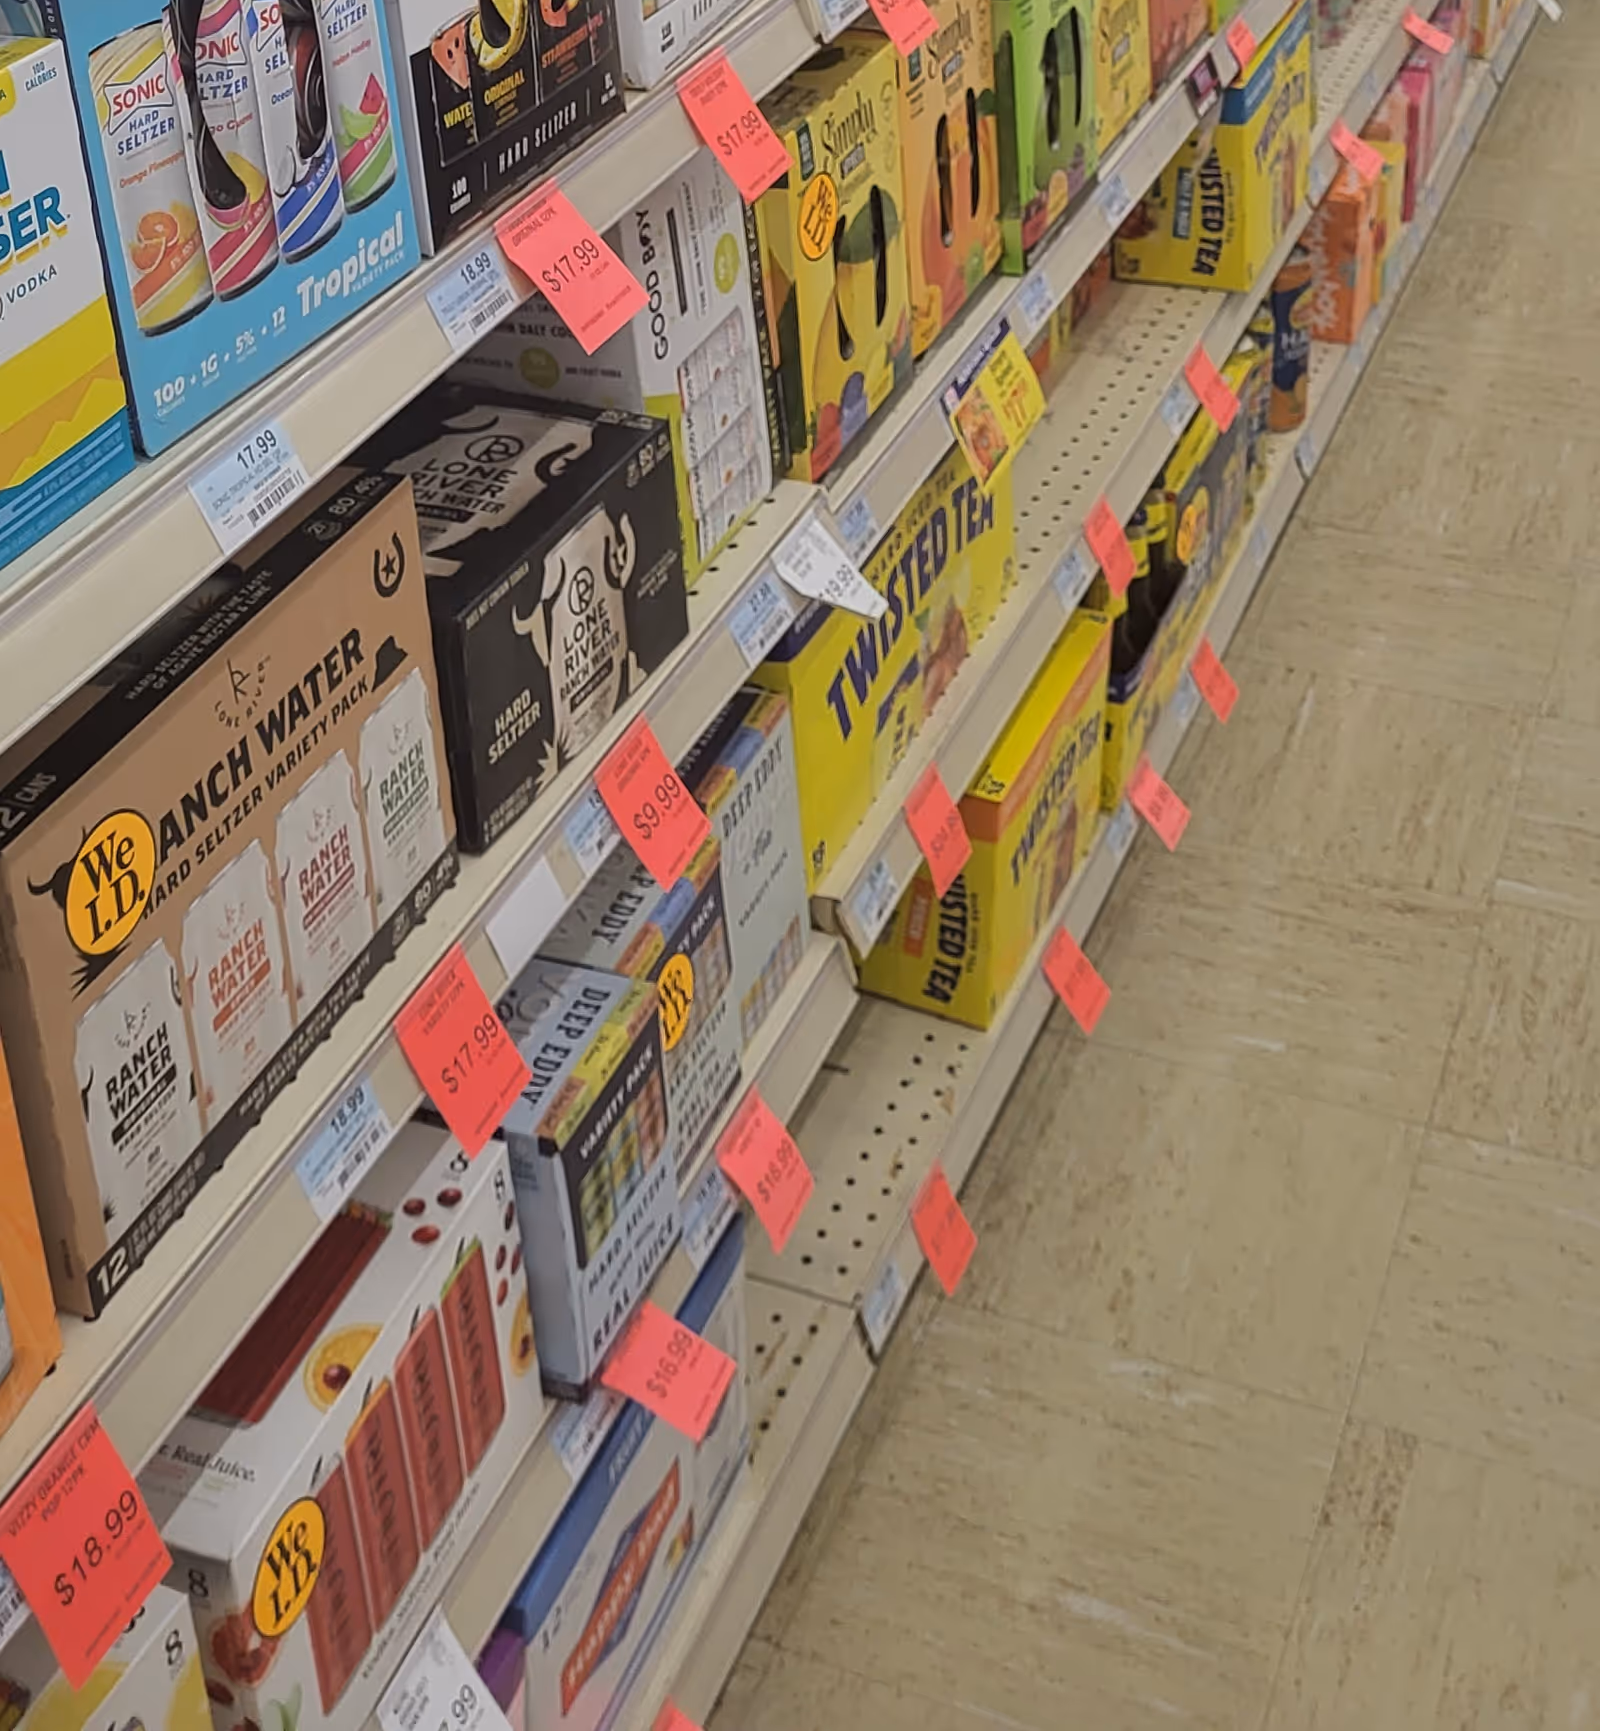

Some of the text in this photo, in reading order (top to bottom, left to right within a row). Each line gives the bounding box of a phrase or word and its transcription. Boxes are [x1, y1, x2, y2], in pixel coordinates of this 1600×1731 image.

[326, 4, 368, 40] SELTZER
[25, 66, 58, 93] CALORIES
[31, 60, 46, 75] 100
[113, 73, 167, 117] SONIC
[117, 117, 176, 157] SELTZER
[128, 109, 160, 134] HARD
[498, 100, 578, 176] HARD SELTZER
[716, 109, 763, 157] $17.99
[6, 264, 58, 306] VODKA
[297, 211, 404, 317] Tropical
[459, 250, 492, 285] 18.99
[541, 237, 601, 294] $17.99
[154, 376, 186, 407] 100
[234, 329, 256, 356] 5%
[272, 305, 287, 328] 12
[236, 428, 279, 471] 17.99
[563, 597, 608, 653] LONE
[826, 506, 950, 742] TWISTED
[952, 474, 996, 555] TEA
[559, 630, 621, 702] RANCH WATER
[564, 619, 612, 678] RIVER
[489, 701, 542, 765] SELTZER
[495, 688, 532, 736] HARD
[157, 628, 366, 867] ANCH WATER
[194, 787, 265, 865] SELTZER
[264, 716, 331, 792] VARIETY
[331, 674, 370, 727] PACK
[380, 739, 425, 800] RANCH
[17, 771, 58, 805] CANS
[381, 761, 426, 819] WATER
[632, 771, 682, 842] $9.99
[80, 829, 136, 896] We
[297, 825, 350, 888] RANCH
[299, 844, 352, 909] WATER
[83, 866, 147, 947] I.D.
[591, 889, 646, 947] EDDY
[206, 919, 265, 990] RANCH
[209, 940, 269, 1010] WATER
[104, 1020, 170, 1103] RANCH
[440, 1011, 500, 1096] $17.99
[520, 986, 611, 1112] DEEP EDDY
[108, 1044, 176, 1124] WATER
[578, 1045, 656, 1161] VARIETY PACK
[95, 1251, 130, 1297] 12
[592, 1213, 675, 1352] REAL JUICE
[53, 1487, 141, 1608] $18.99
[188, 1567, 210, 1599] 8
[164, 1628, 185, 1668] 8
